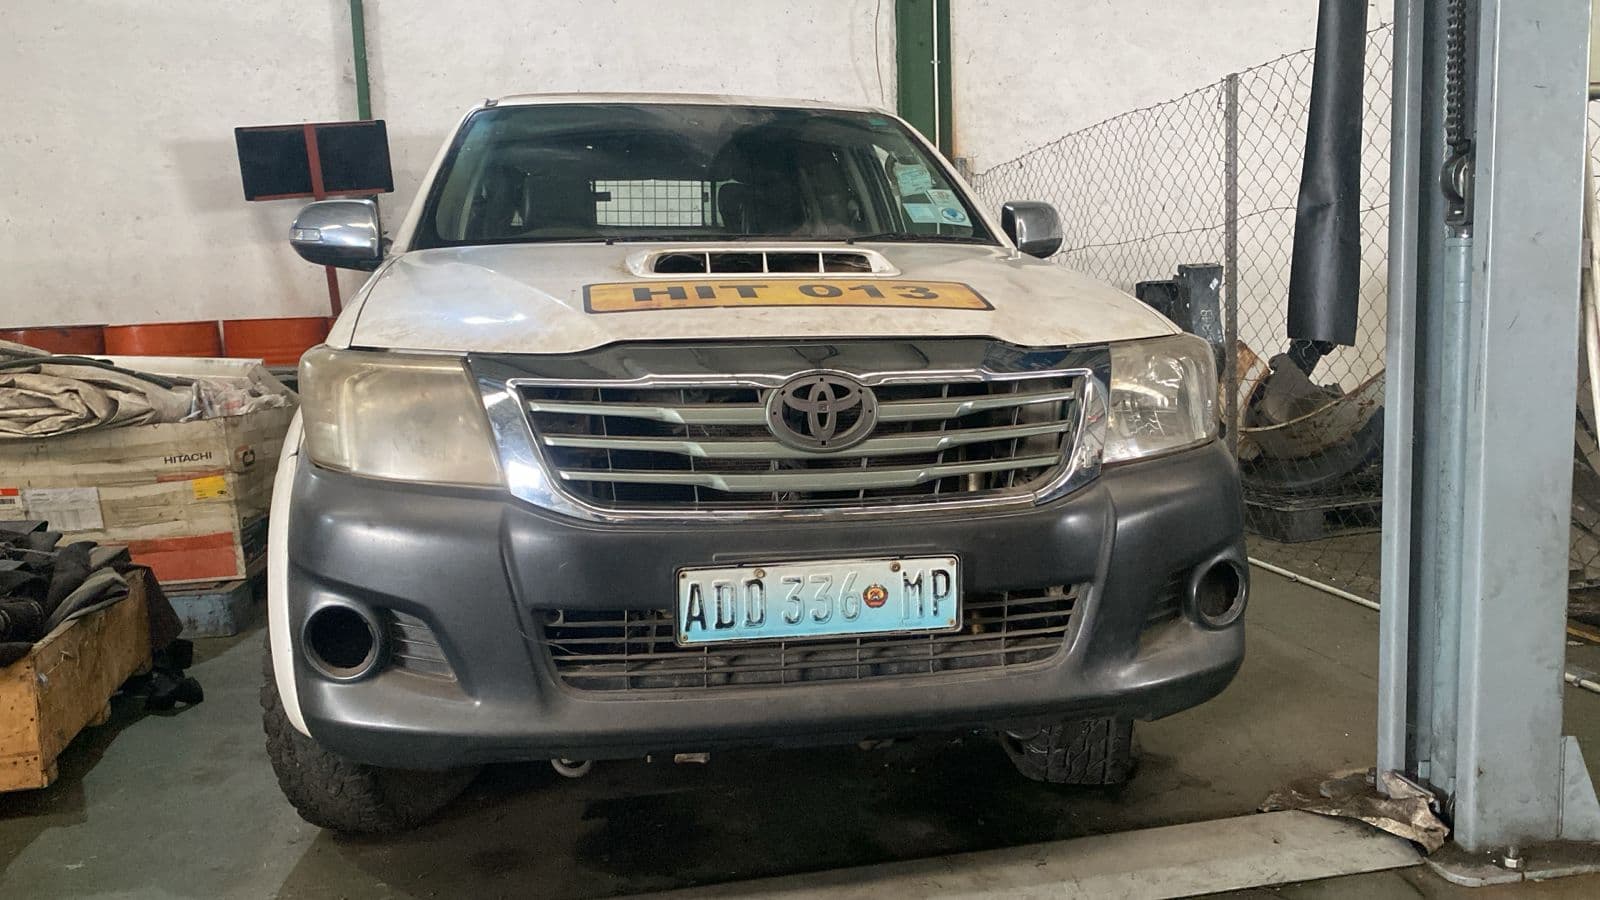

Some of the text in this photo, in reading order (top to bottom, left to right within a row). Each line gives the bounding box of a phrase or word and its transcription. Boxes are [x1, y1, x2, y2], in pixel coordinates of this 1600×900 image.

[632, 283, 939, 302] HIT 013
[163, 451, 213, 465] HITACHI
[684, 568, 951, 632] ADD 336 MP
